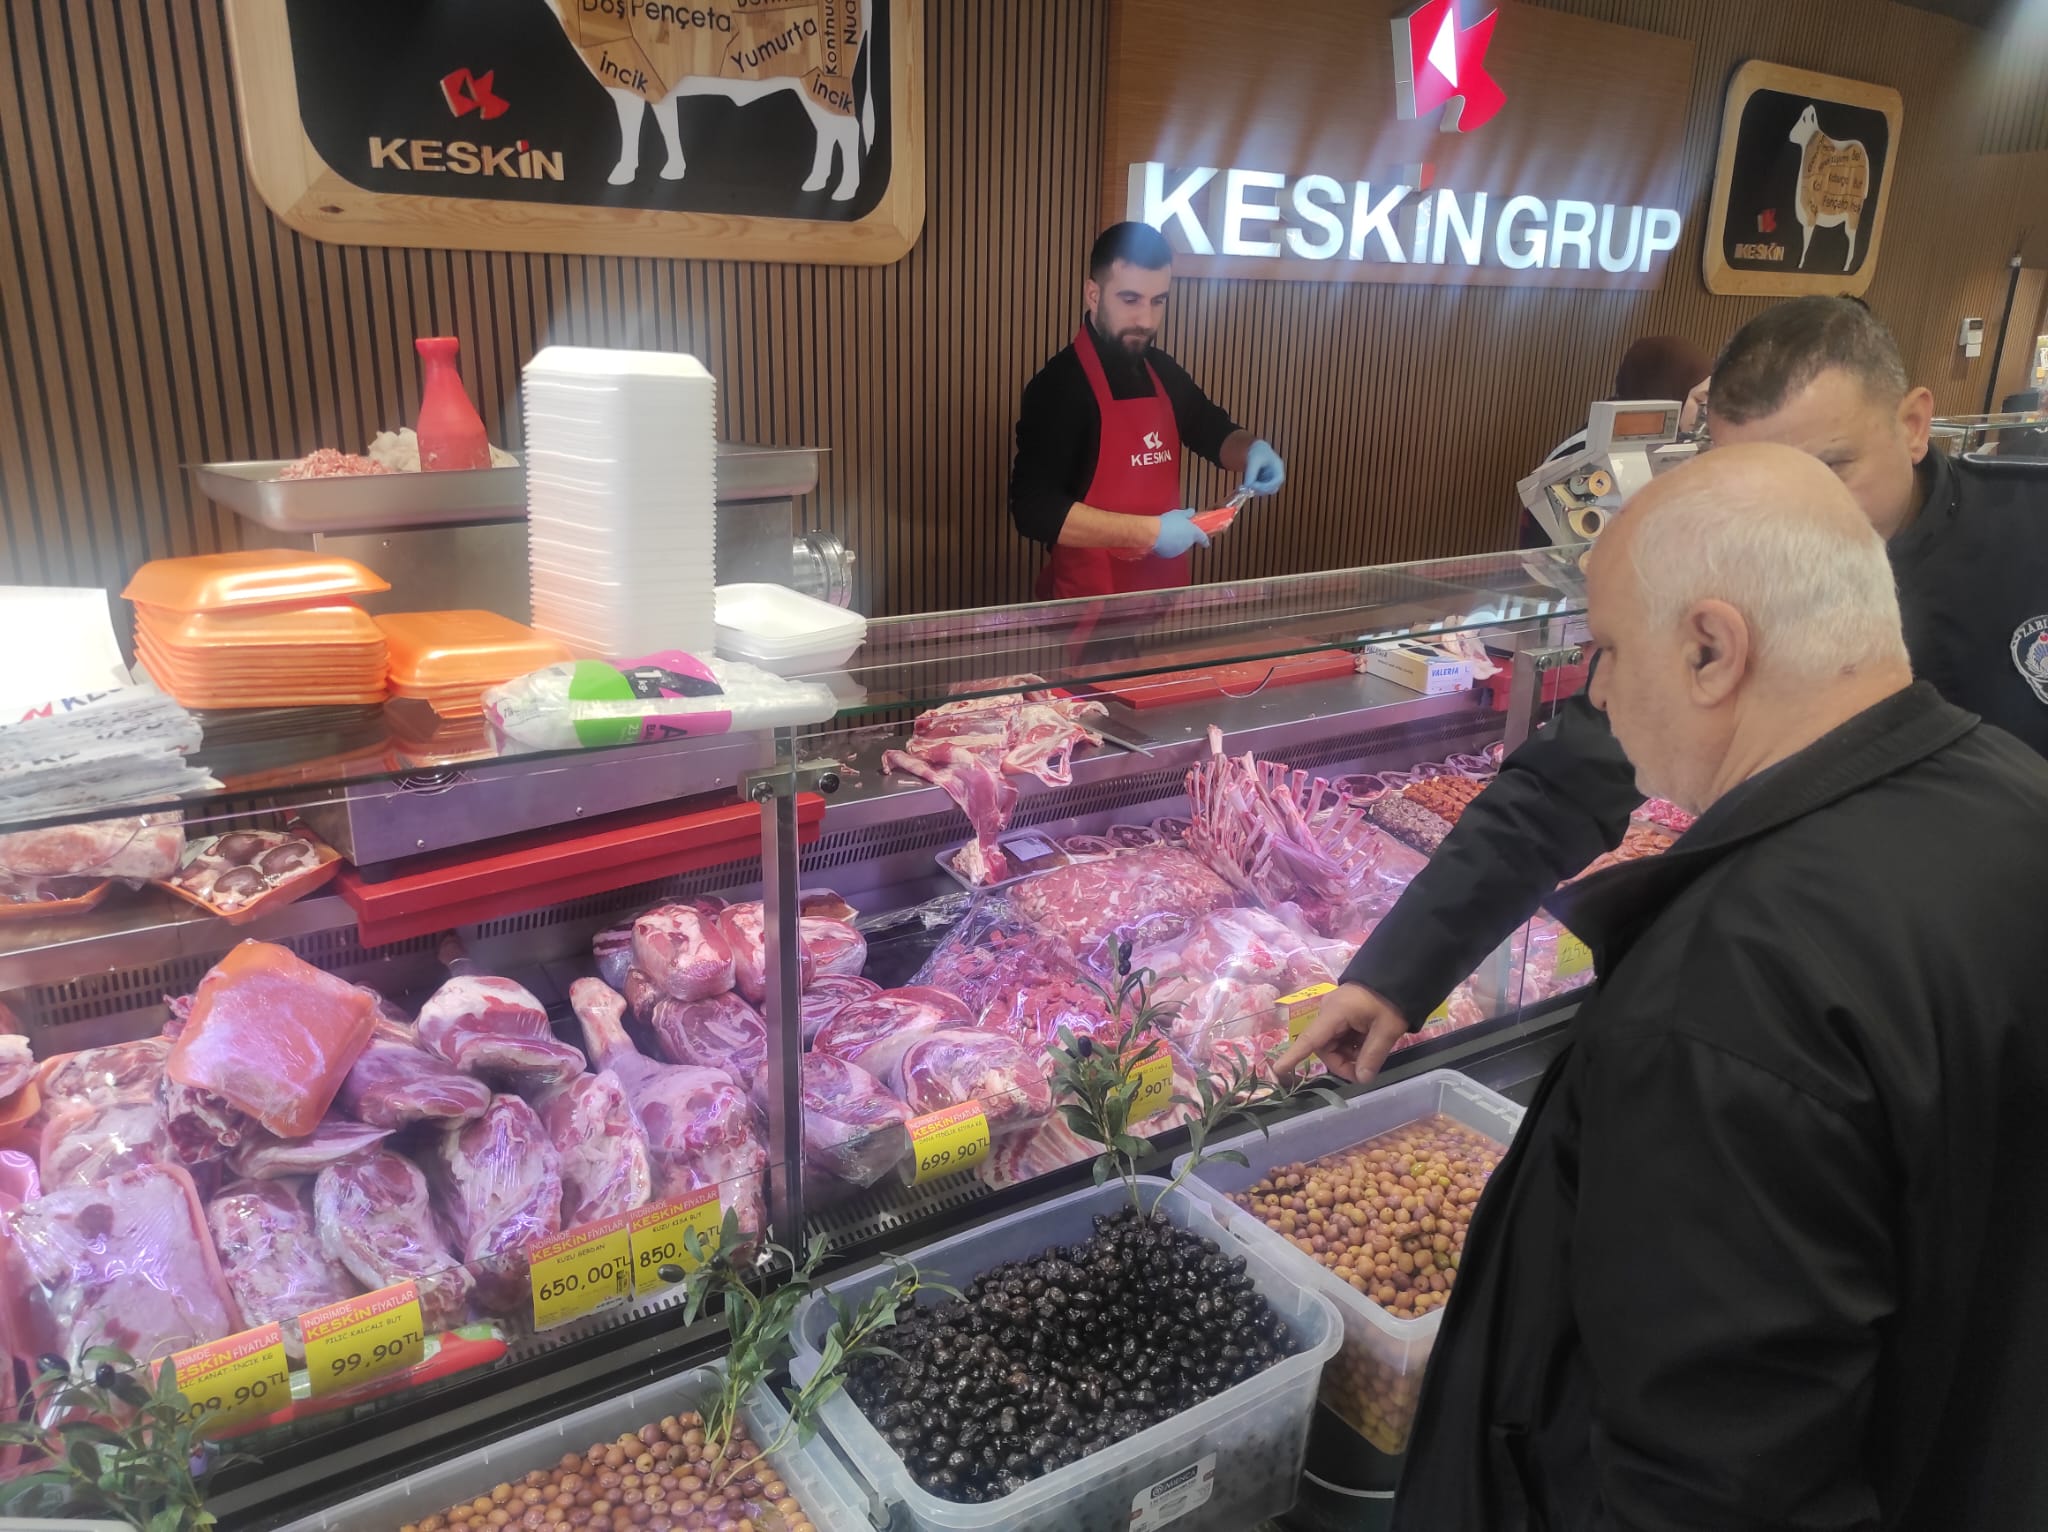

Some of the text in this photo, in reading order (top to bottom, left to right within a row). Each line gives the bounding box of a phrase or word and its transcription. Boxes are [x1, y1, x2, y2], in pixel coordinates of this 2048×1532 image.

[631, 0, 731, 34] Pençeta
[731, 17, 817, 74] Yumurta
[600, 50, 648, 94] İncik
[812, 74, 852, 114] İncik
[1496, 194, 1681, 273] GRUP
[1432, 667, 1459, 677] VALERIA
[175, 1350, 232, 1381] ESKİN
[198, 1367, 227, 1383] KANAT
